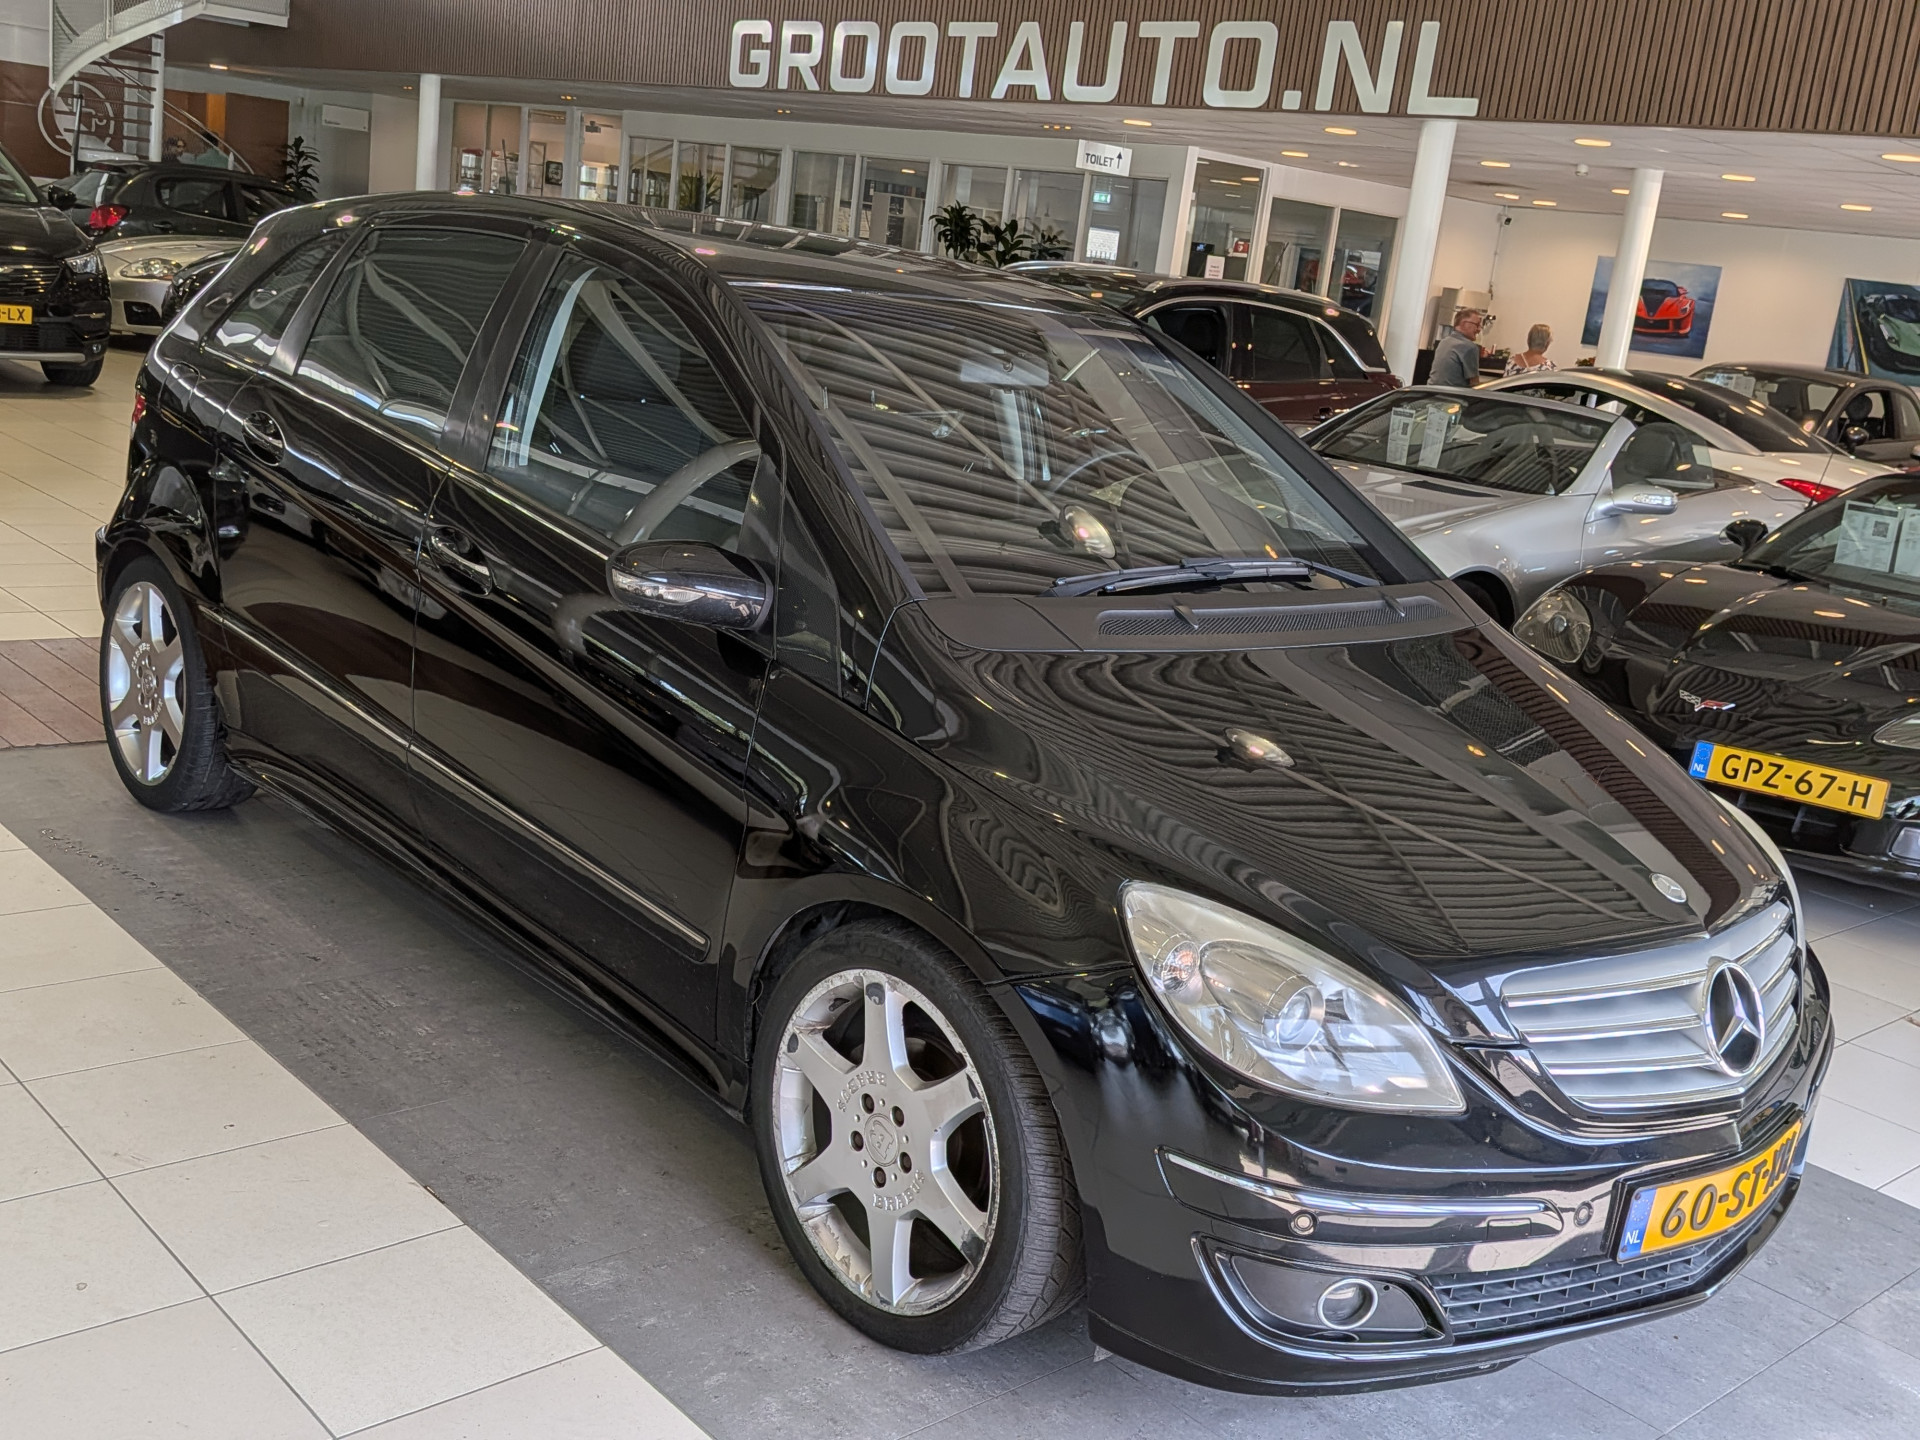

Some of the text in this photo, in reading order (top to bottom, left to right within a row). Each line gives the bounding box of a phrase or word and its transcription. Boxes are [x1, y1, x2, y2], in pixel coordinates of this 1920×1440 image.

[729, 20, 1480, 117] GROOTAUTO.NL
[1085, 152, 1115, 168] TOILET
[0, 307, 26, 322] -LX
[1693, 762, 1707, 773] NL
[1721, 754, 1873, 810] GPZ-67-H
[1624, 1230, 1641, 1245] NL
